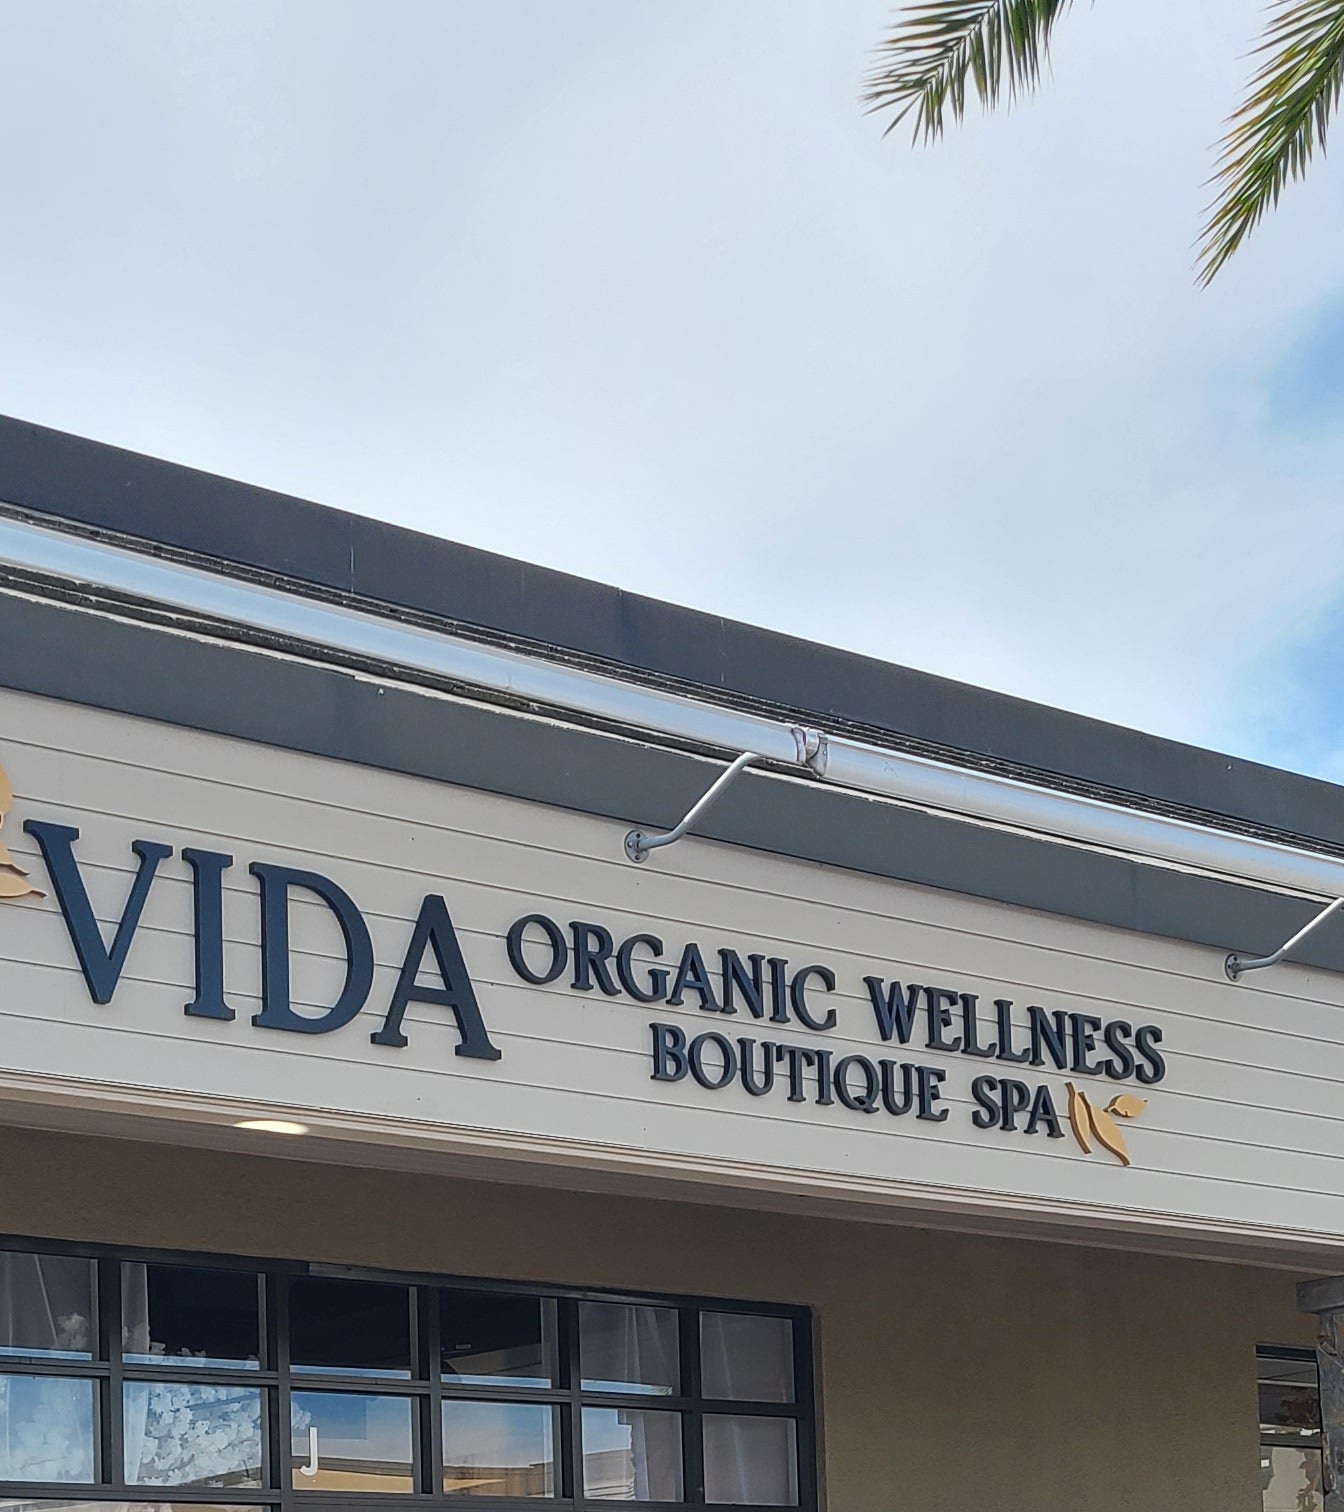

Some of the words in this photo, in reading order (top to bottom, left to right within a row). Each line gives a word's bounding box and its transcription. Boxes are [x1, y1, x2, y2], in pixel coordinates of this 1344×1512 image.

[22, 818, 503, 1061] VIDA
[506, 912, 838, 1032] ORGANIC
[862, 974, 1167, 1085] WELLNESS
[649, 1021, 950, 1122] BOUTIQUE
[971, 1074, 1066, 1139] SPA
